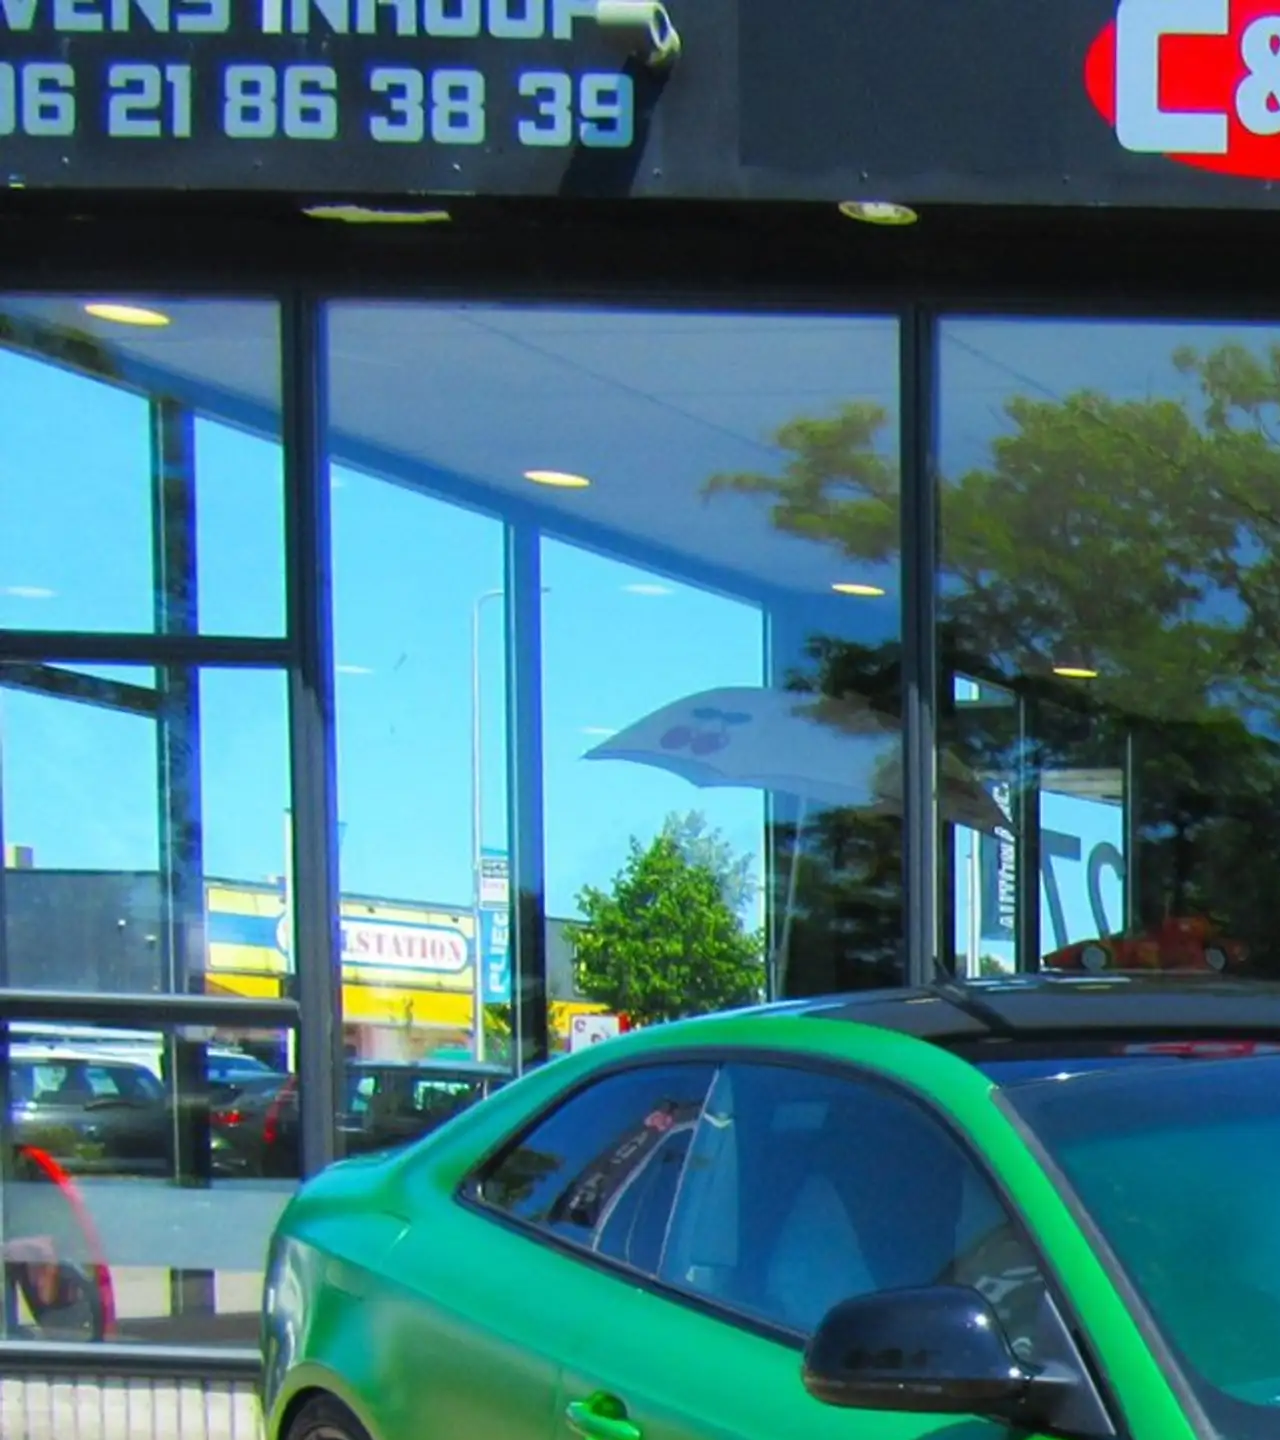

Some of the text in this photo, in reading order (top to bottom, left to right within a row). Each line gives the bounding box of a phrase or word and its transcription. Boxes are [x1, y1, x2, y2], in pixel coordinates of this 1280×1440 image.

[0, 62, 635, 148] 6 21 86 38 39
